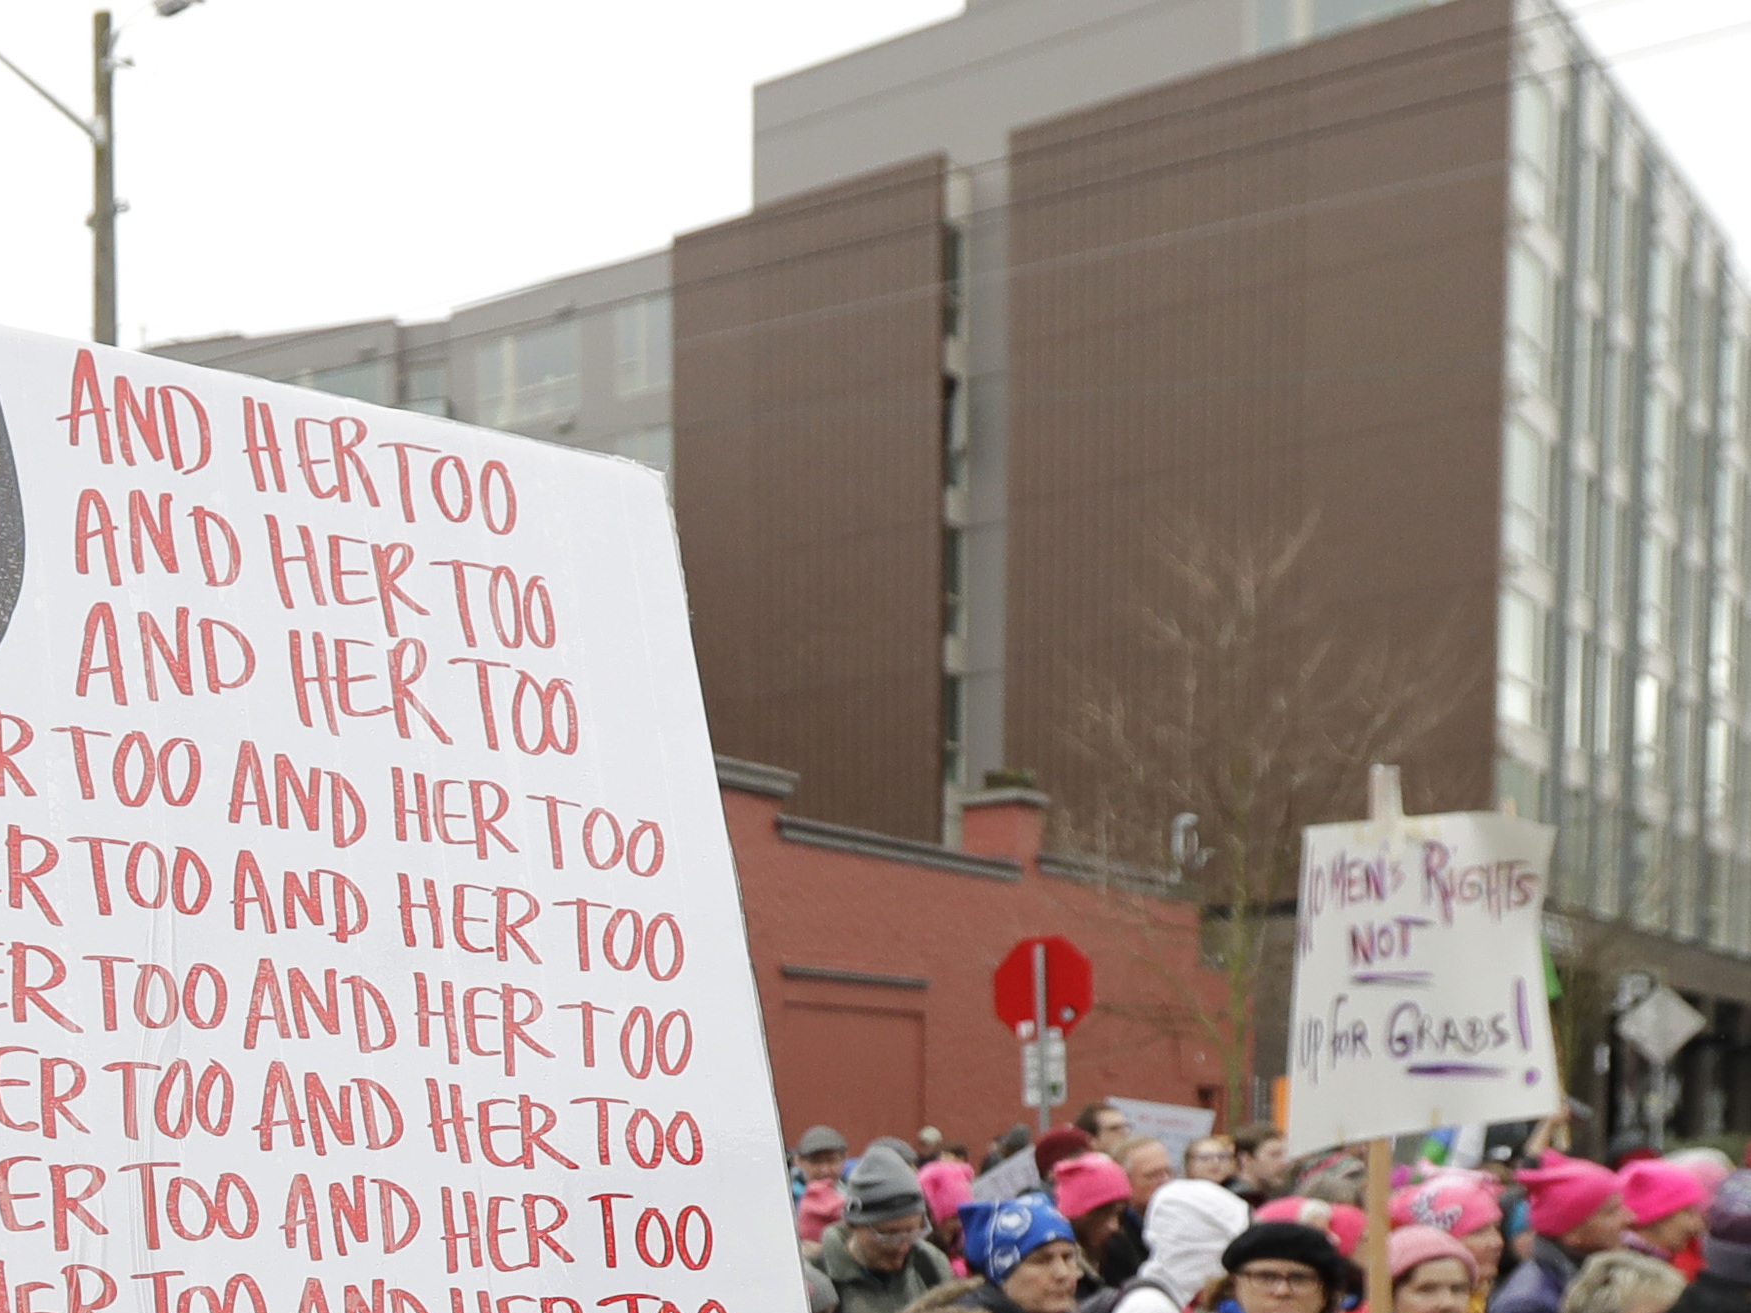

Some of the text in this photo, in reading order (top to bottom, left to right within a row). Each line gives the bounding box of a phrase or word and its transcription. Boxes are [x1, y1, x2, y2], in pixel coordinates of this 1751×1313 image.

[57, 349, 211, 475] AND
[74, 488, 241, 587] AND
[76, 602, 256, 706] AND
[51, 726, 201, 807] TOO
[228, 740, 367, 848] AND
[391, 766, 519, 860] HER
[527, 794, 664, 877] TOO
[67, 837, 212, 916] TOO
[230, 849, 368, 943] AND
[398, 872, 542, 965] HER
[552, 898, 684, 982] TOO
[1350, 915, 1433, 966] NOT
[83, 955, 228, 1031] TOO
[243, 958, 396, 1054] AND
[414, 972, 556, 1077] HER
[557, 1000, 692, 1080] TOO
[102, 1060, 234, 1141] TOO
[253, 1060, 404, 1156] AND
[427, 1078, 580, 1170] HER
[570, 1098, 703, 1170] TOO
[119, 1162, 259, 1250] TOO
[279, 1174, 420, 1261] AND
[441, 1186, 574, 1274] HER
[588, 1193, 712, 1271] TOO
